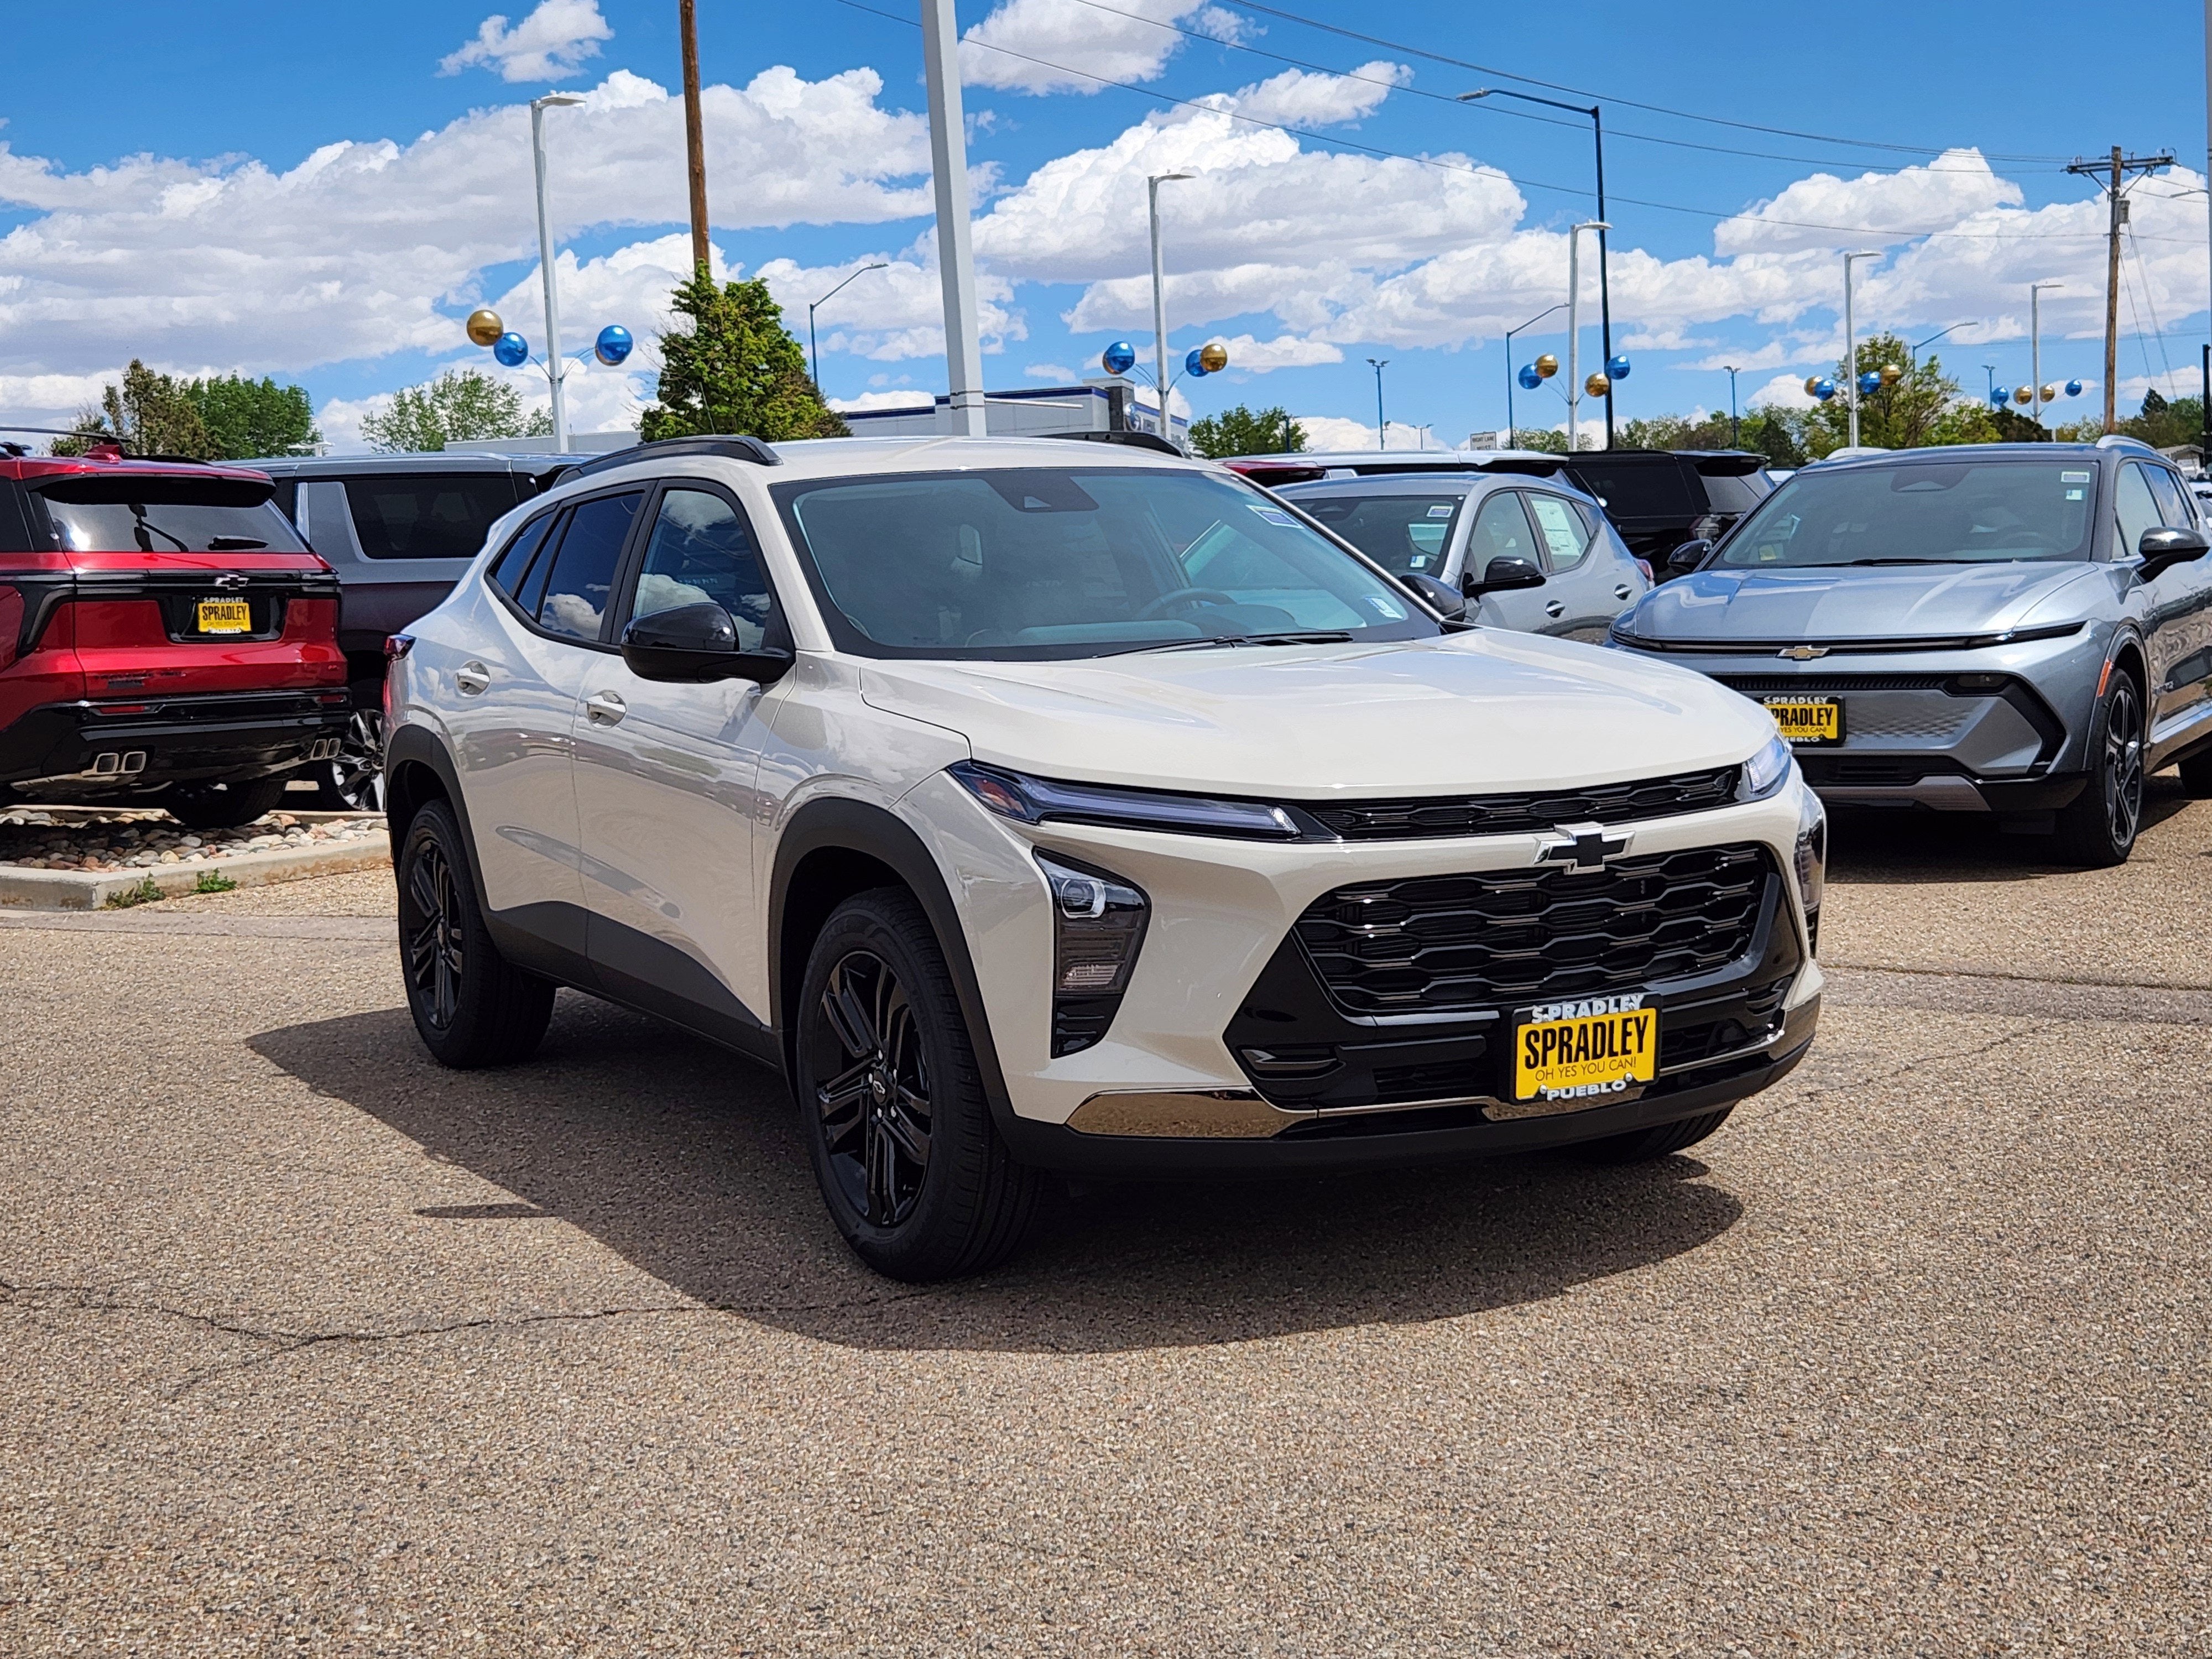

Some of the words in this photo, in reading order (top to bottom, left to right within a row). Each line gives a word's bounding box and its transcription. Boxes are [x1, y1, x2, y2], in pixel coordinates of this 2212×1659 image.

[202, 606, 247, 620] SPRADLEY
[1764, 696, 1828, 705] SPRADLEY
[1770, 707, 1833, 726] PRADLEY
[1531, 995, 1644, 1023] SPRADLEY
[1525, 1015, 1649, 1069] SPRADLEY
[1535, 1068, 1554, 1081] OH
[1558, 1065, 1577, 1078] YES
[1580, 1061, 1605, 1076] YOU
[1609, 1056, 1636, 1071] CAN!
[1547, 1079, 1626, 1101] PUEBLO
